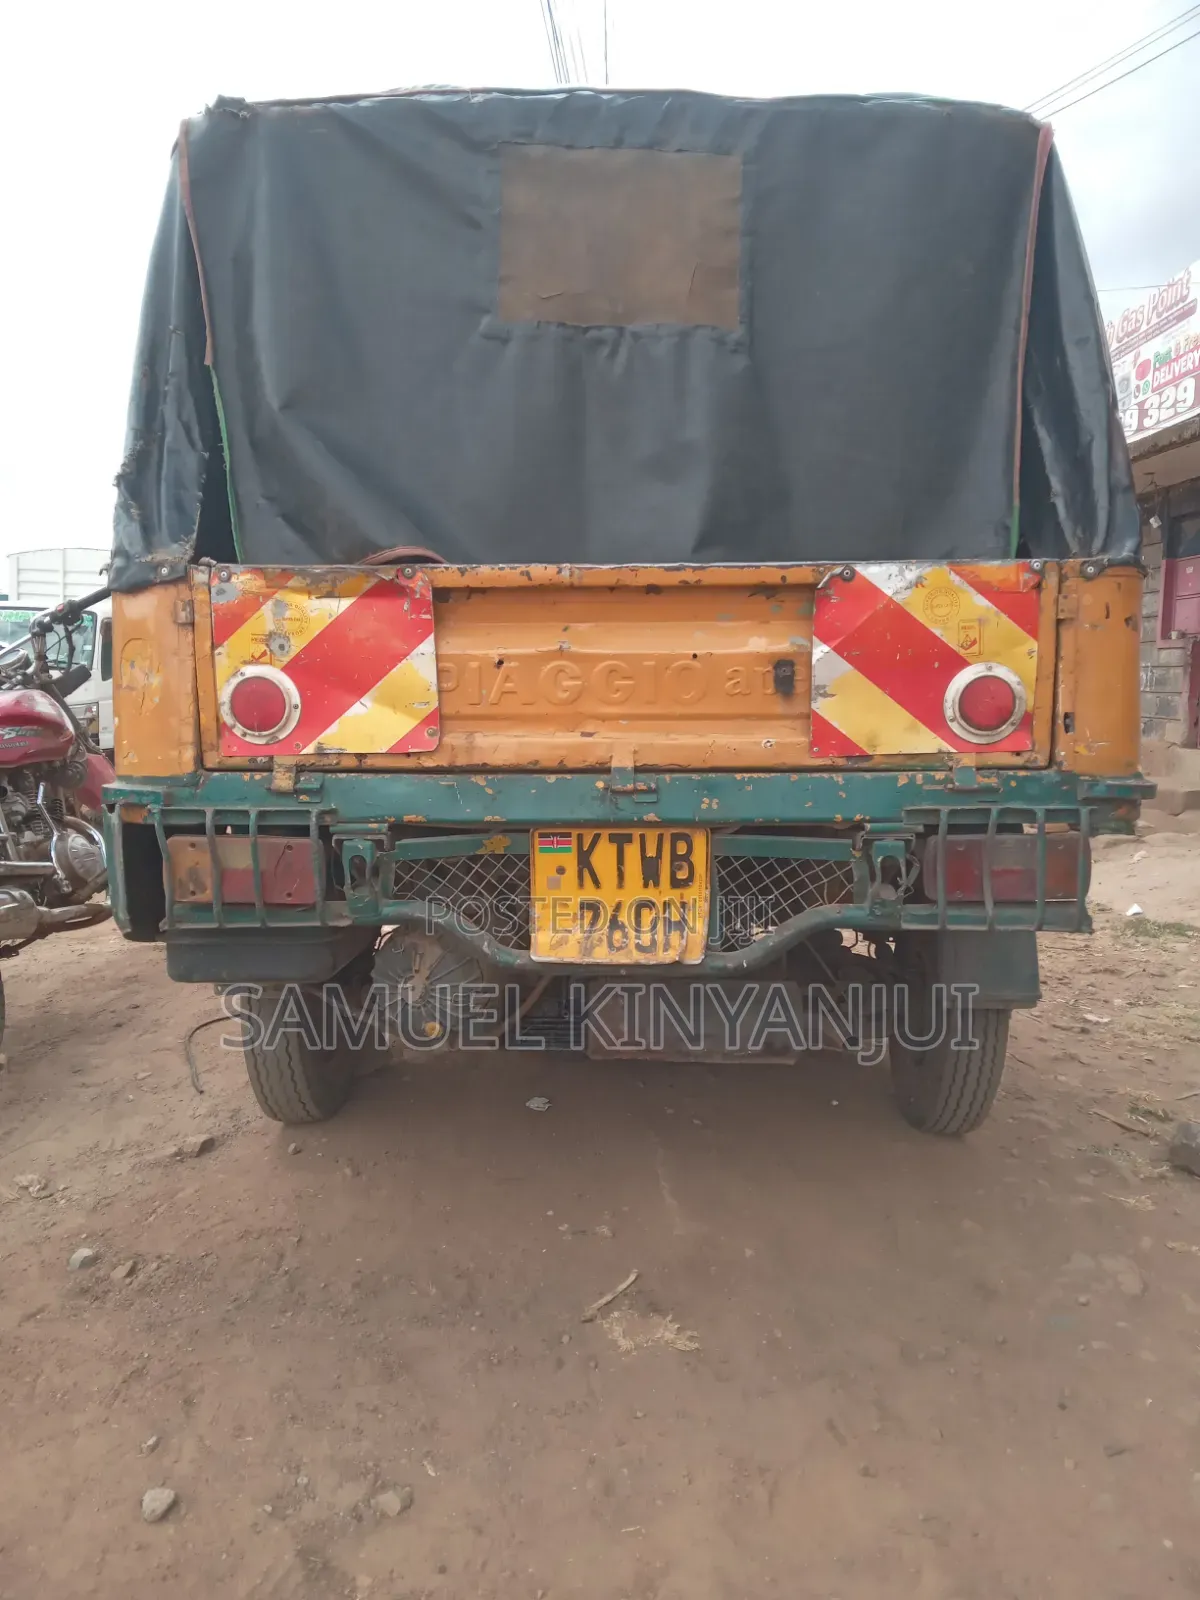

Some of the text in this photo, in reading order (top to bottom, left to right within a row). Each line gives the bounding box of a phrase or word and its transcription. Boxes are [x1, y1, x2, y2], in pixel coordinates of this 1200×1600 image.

[1116, 305, 1145, 343] Gas
[1146, 267, 1191, 326] Point
[1153, 347, 1200, 387] DELIVERY
[1143, 378, 1195, 427] 329
[576, 832, 695, 889] KTWB
